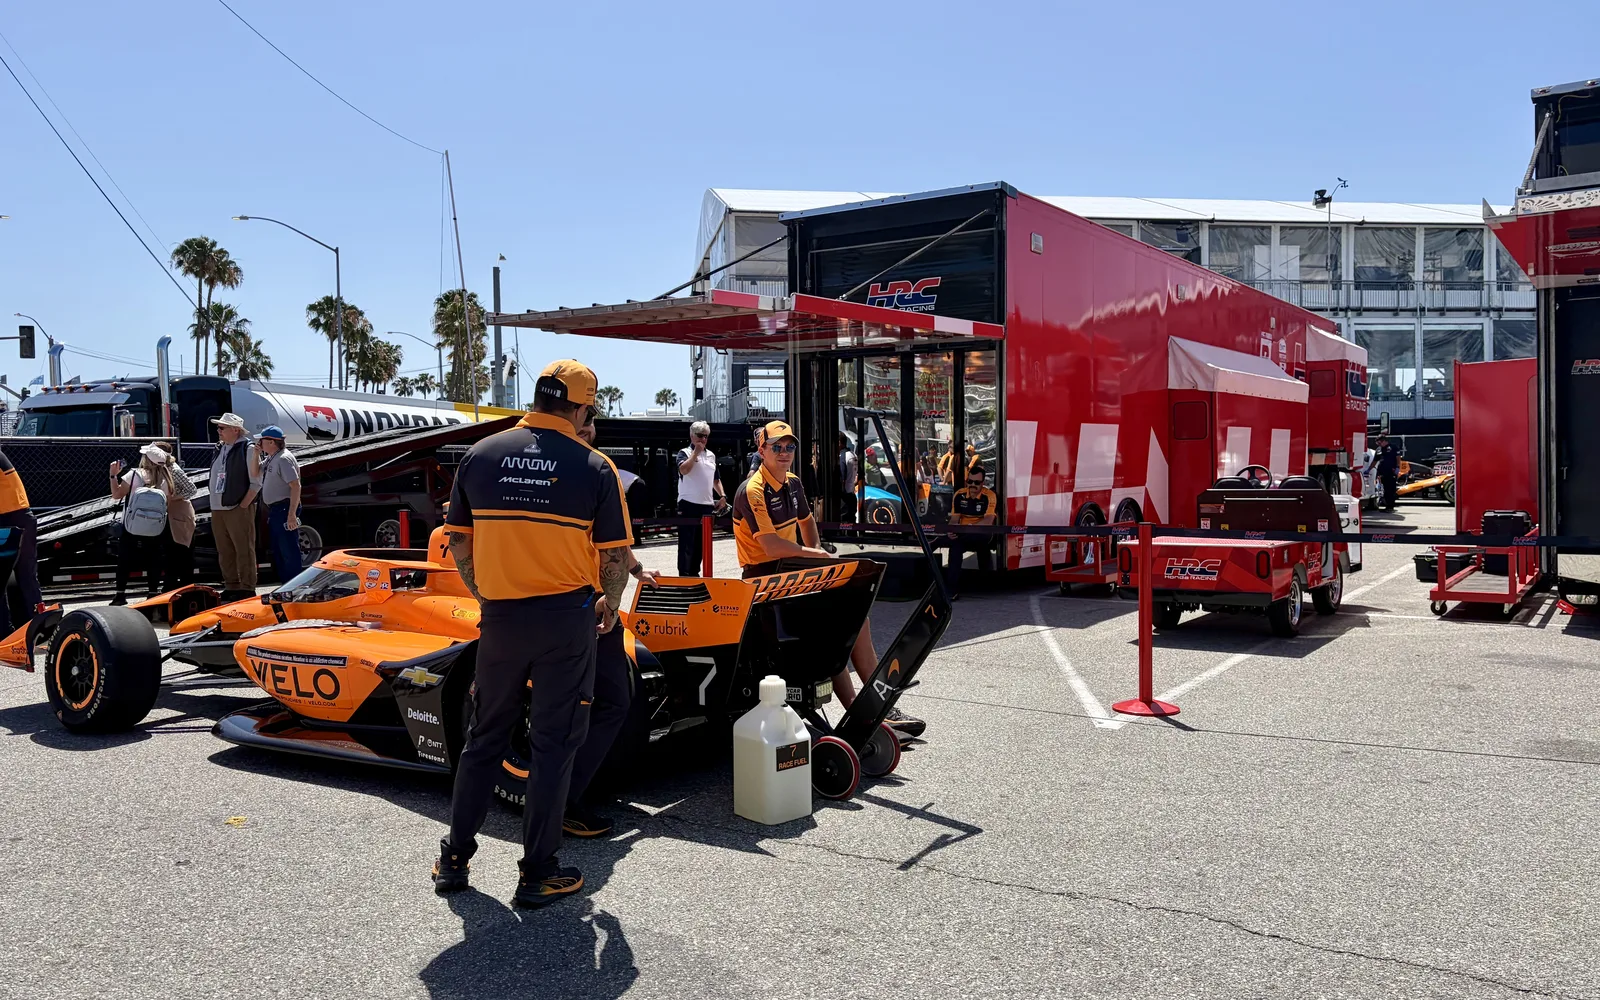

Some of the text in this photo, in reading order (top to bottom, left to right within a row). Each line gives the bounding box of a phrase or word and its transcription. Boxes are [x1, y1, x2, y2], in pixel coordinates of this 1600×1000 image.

[866, 276, 942, 309] HRC
[1571, 359, 1600, 373] HR
[339, 408, 461, 439] INDY
[501, 456, 557, 472] ARROW
[498, 476, 551, 487] McLaren
[1164, 557, 1222, 577] HRC
[654, 619, 689, 637] rubrik
[250, 659, 341, 701] VELO
[685, 655, 717, 706] 7
[407, 707, 440, 725] Deloitte.
[417, 750, 445, 763] Firestone
[789, 744, 797, 757] 7
[778, 757, 807, 770] RACE FUEL
